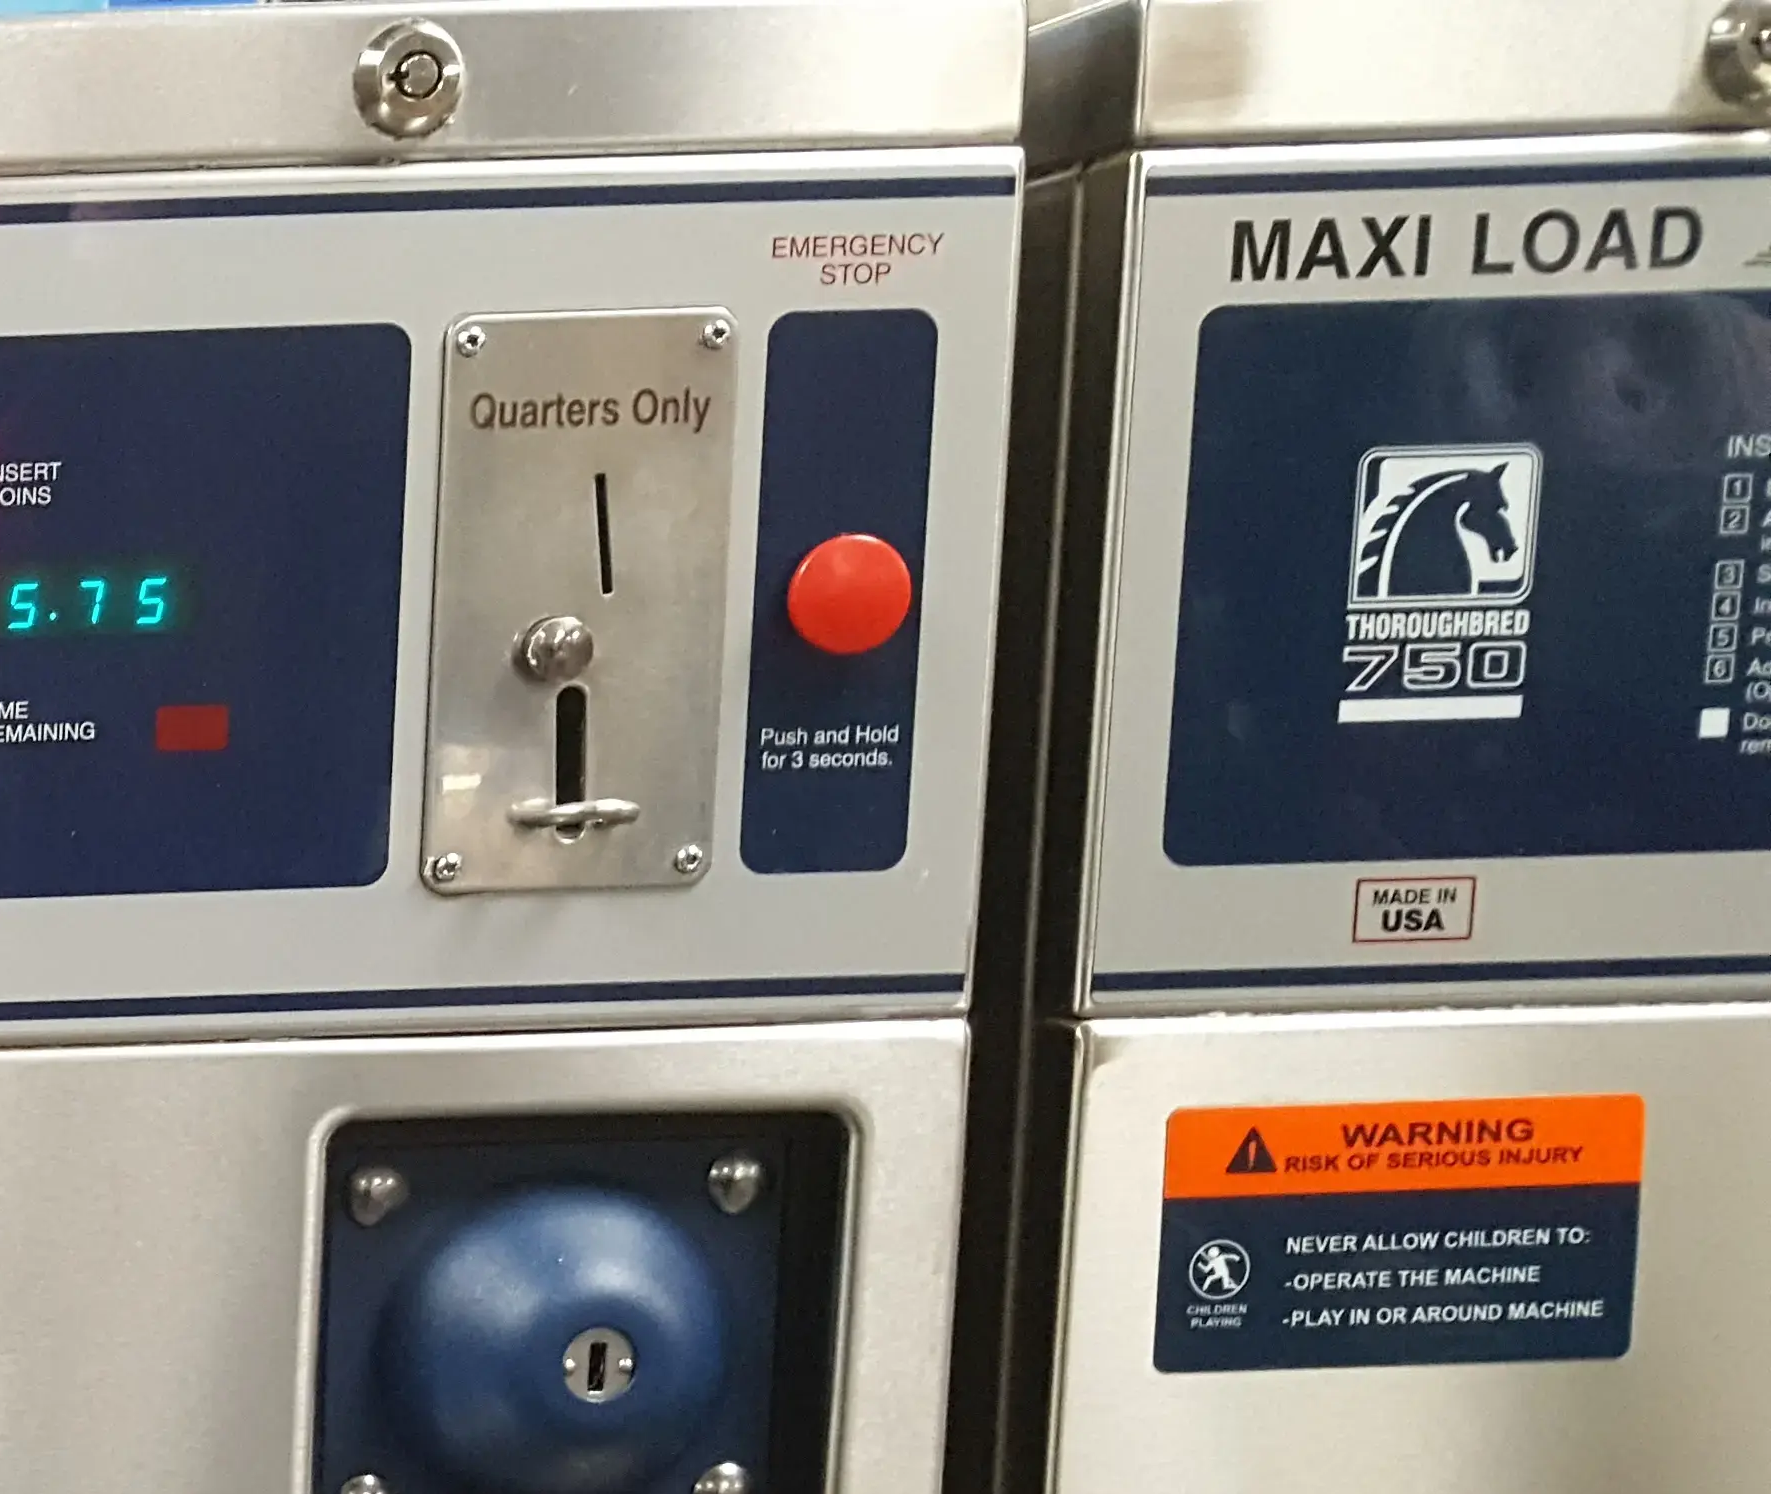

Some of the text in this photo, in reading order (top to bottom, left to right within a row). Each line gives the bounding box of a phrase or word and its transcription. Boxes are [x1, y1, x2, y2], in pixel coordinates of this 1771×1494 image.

[772, 233, 944, 258] EMERGENCY
[1231, 207, 1702, 281] MAXI LOAD
[820, 263, 891, 285] STOP
[470, 388, 711, 434] Quarters Only
[1343, 610, 1529, 641] THOROUGHBRED
[1343, 641, 1527, 692] 750
[761, 725, 899, 746] Push and Hold
[762, 748, 892, 769] for 3 seconds.
[1373, 888, 1456, 905] MADE IN
[1382, 909, 1444, 932] USA
[1342, 1119, 1533, 1148] WARNING
[1284, 1146, 1583, 1173] RISK OF SERIOUS INJURY
[1286, 1227, 1590, 1254] NEVER ALLOW CHILDREN TO:
